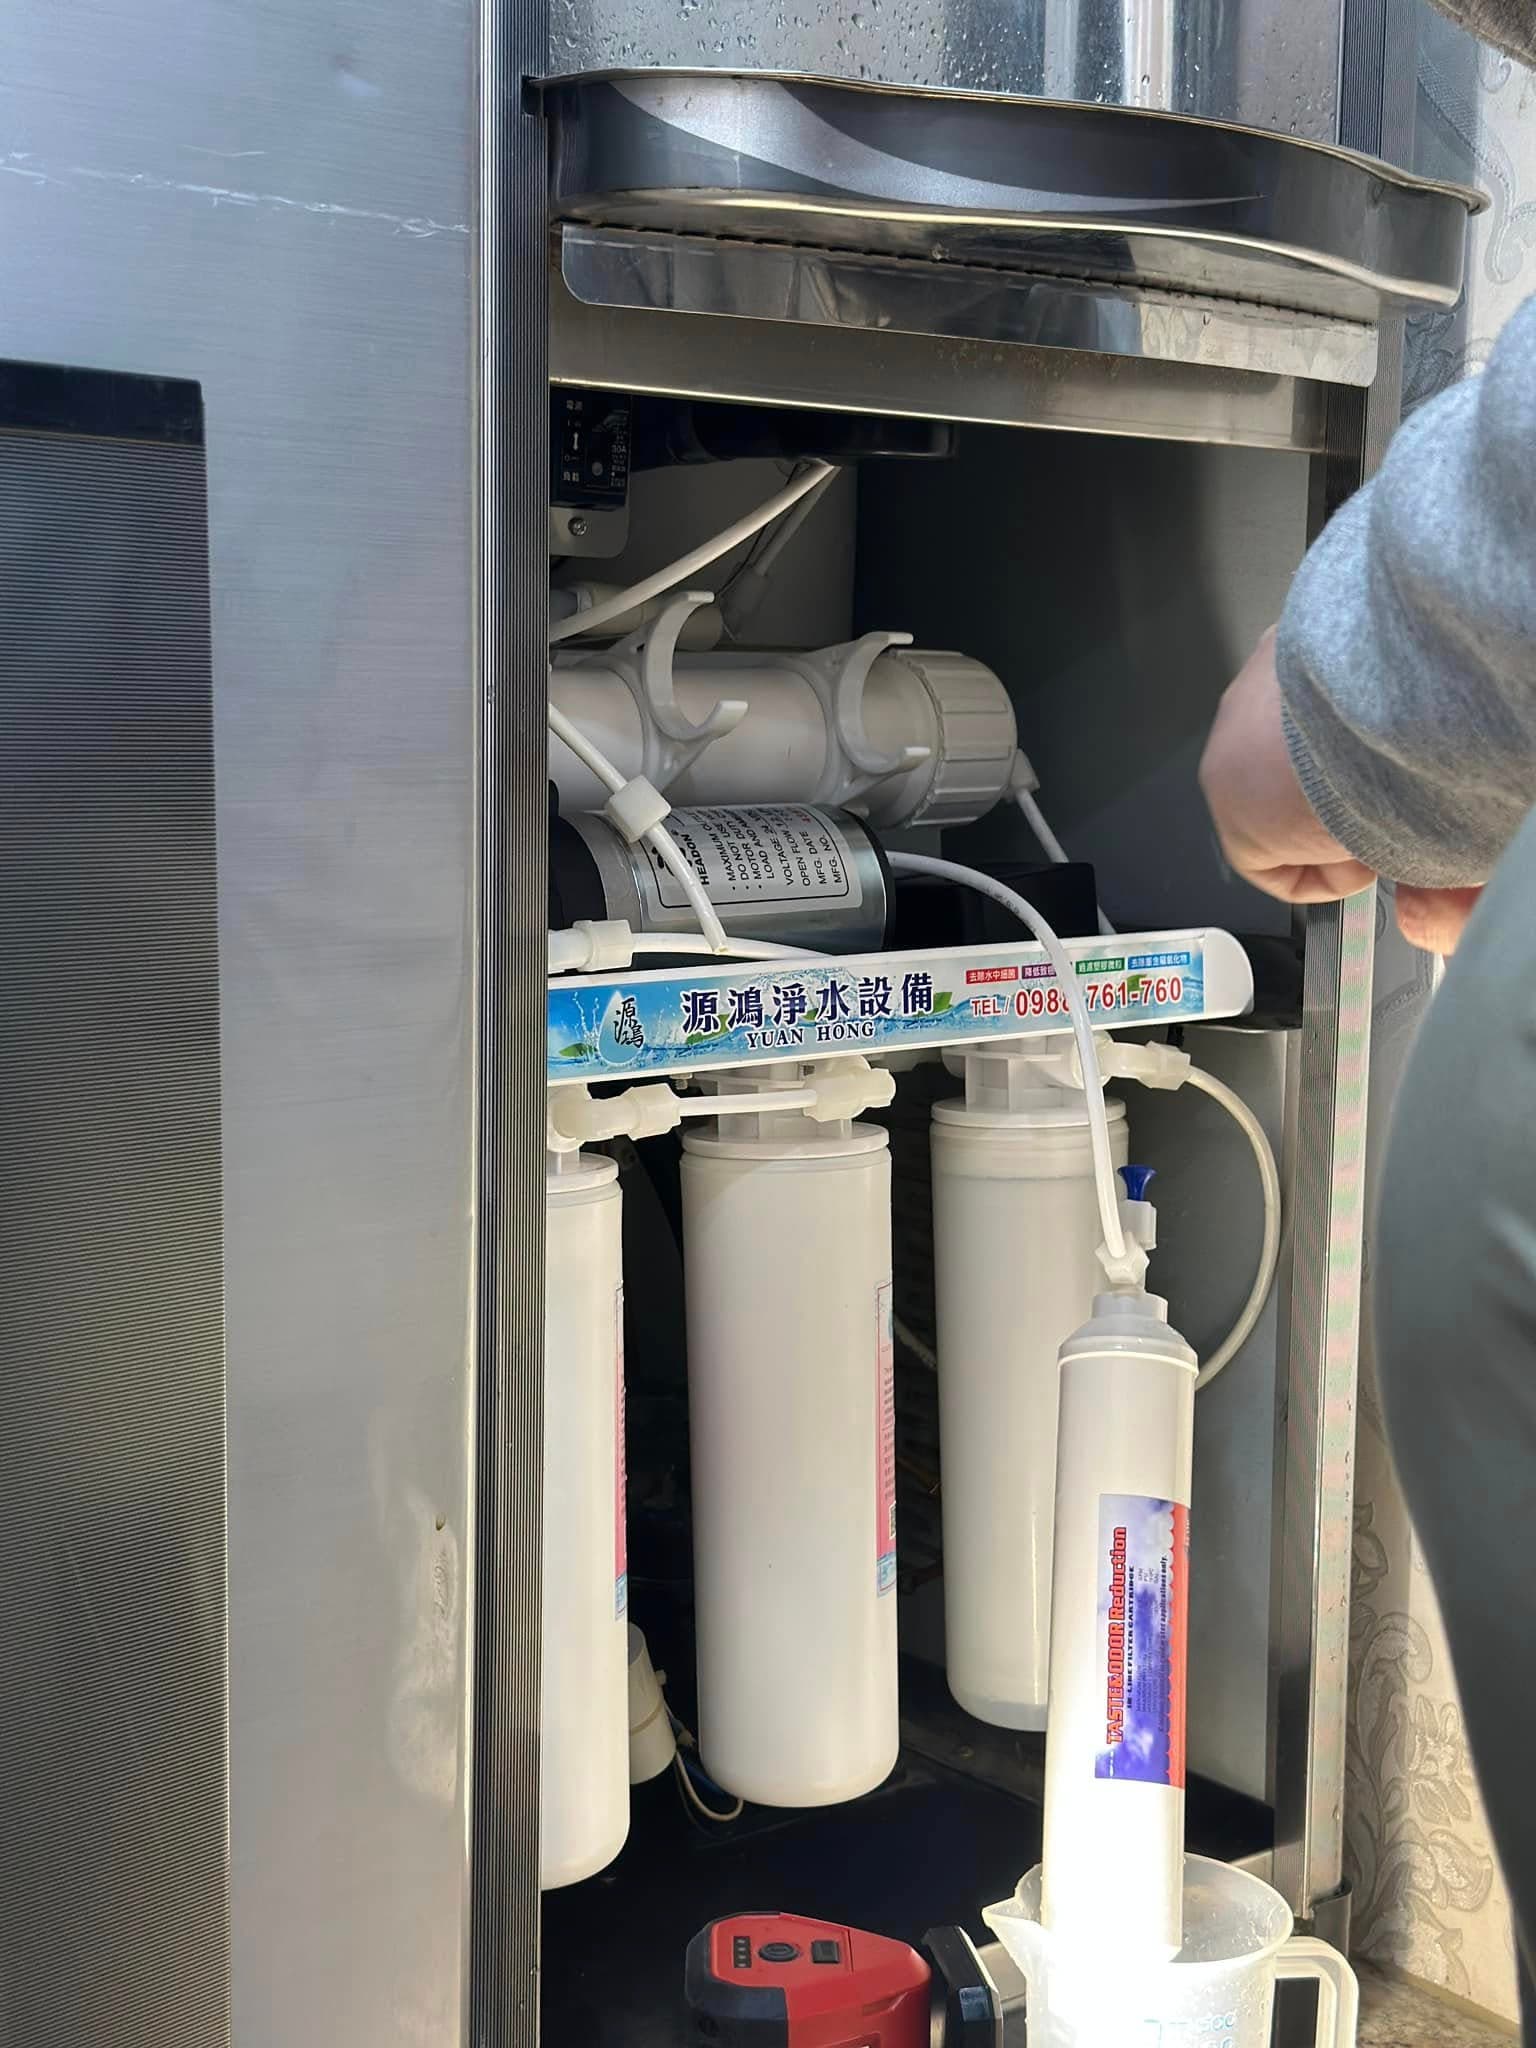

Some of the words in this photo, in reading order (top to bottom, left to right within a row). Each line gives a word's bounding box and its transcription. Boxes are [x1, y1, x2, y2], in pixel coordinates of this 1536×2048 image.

[727, 841, 743, 861] NOT
[746, 829, 763, 848] AND
[781, 830, 801, 854] FLOW
[799, 831, 818, 855] DATE
[819, 834, 832, 852] NO.
[681, 834, 710, 885] HEADON
[709, 833, 737, 881] MAXIMUM
[741, 843, 762, 880] MOTOR
[759, 850, 775, 879] LOAD
[771, 838, 794, 886] VOLTAGE
[796, 856, 811, 886] OPEN
[814, 857, 828, 884] MFG.
[829, 855, 842, 883] MFG.
[738, 864, 750, 880] DO
[681, 971, 934, 1034] 源鴻淨水設備
[1016, 976, 1182, 1016] 098761-760
[747, 1028, 804, 1048] YUAN
[816, 1021, 875, 1041] HONG
[1107, 1525, 1127, 1620] Reduction
[1127, 1564, 1135, 1628] CARTRIDGE
